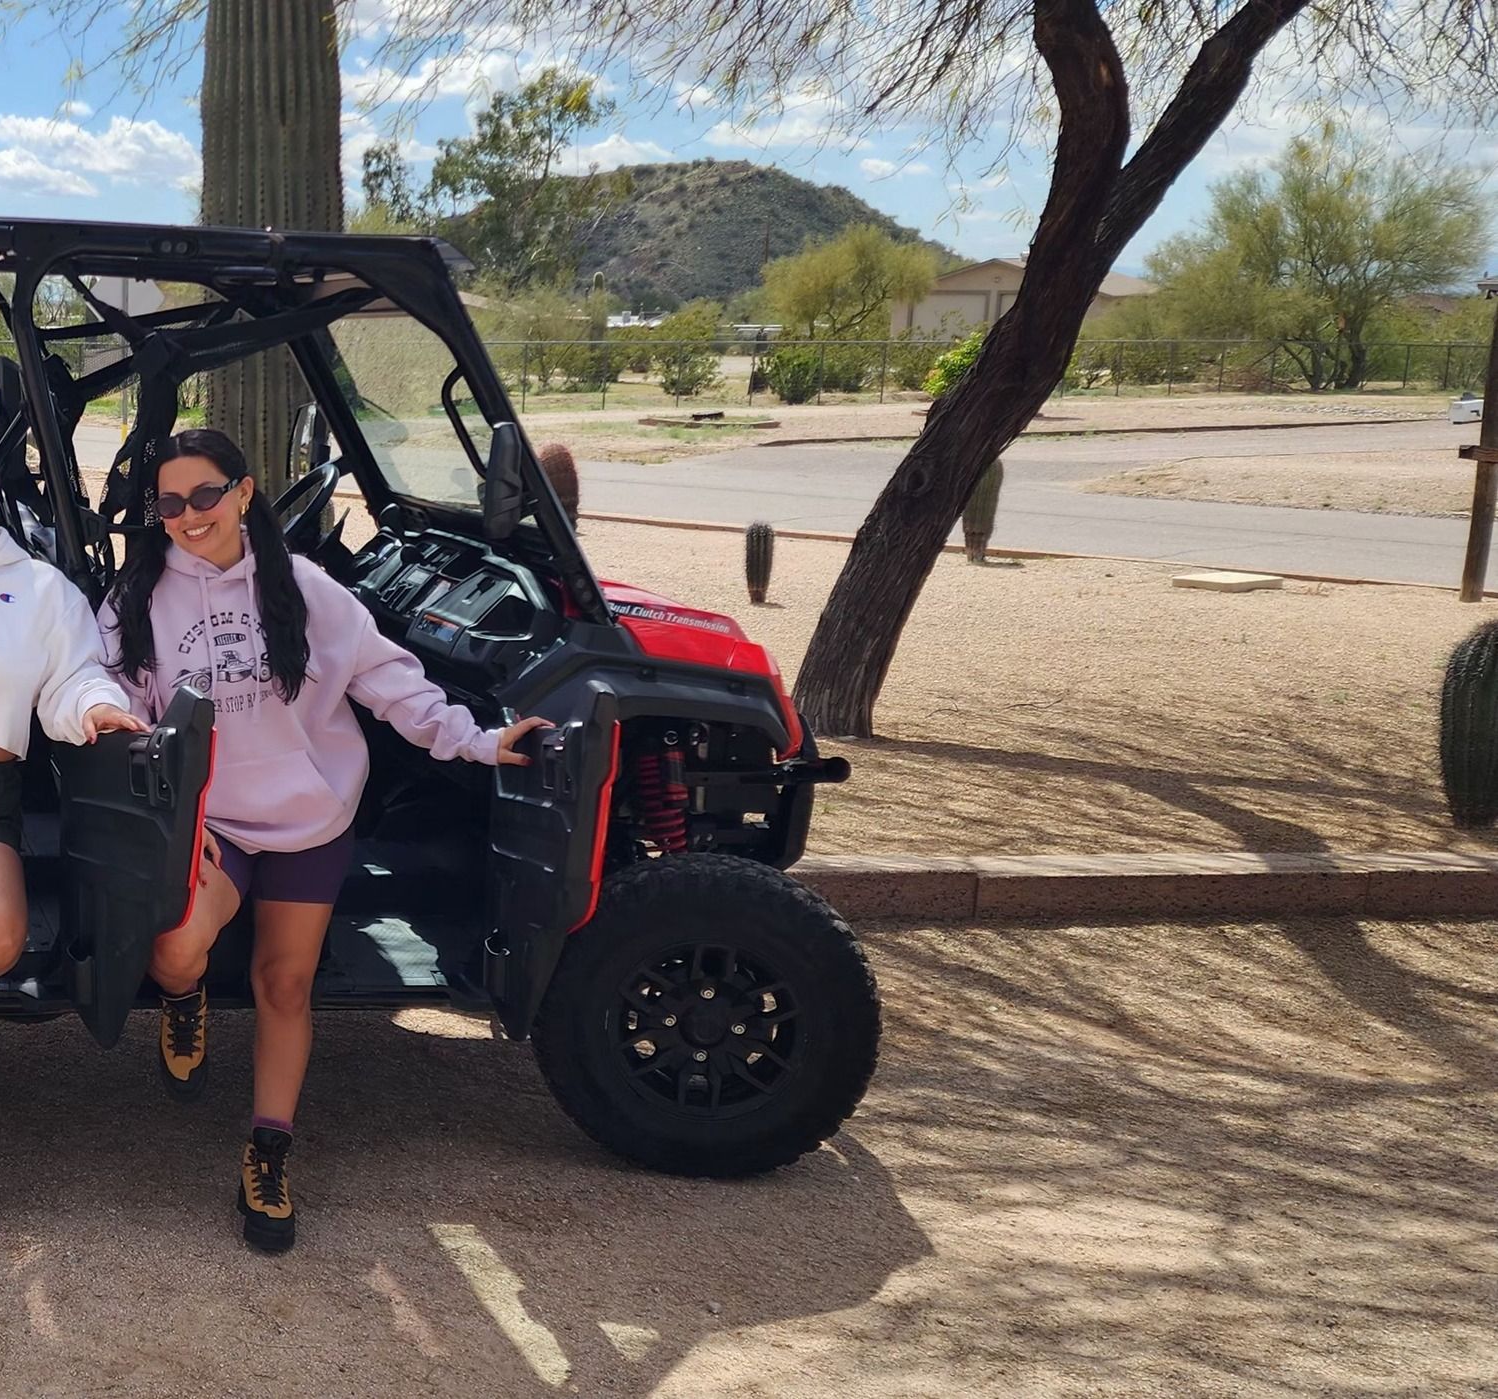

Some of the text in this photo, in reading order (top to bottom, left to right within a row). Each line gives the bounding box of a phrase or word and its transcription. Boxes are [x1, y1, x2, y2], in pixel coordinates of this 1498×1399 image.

[631, 606, 664, 620] Clutch
[665, 612, 731, 633] Transmission
[225, 694, 244, 713] STOP
